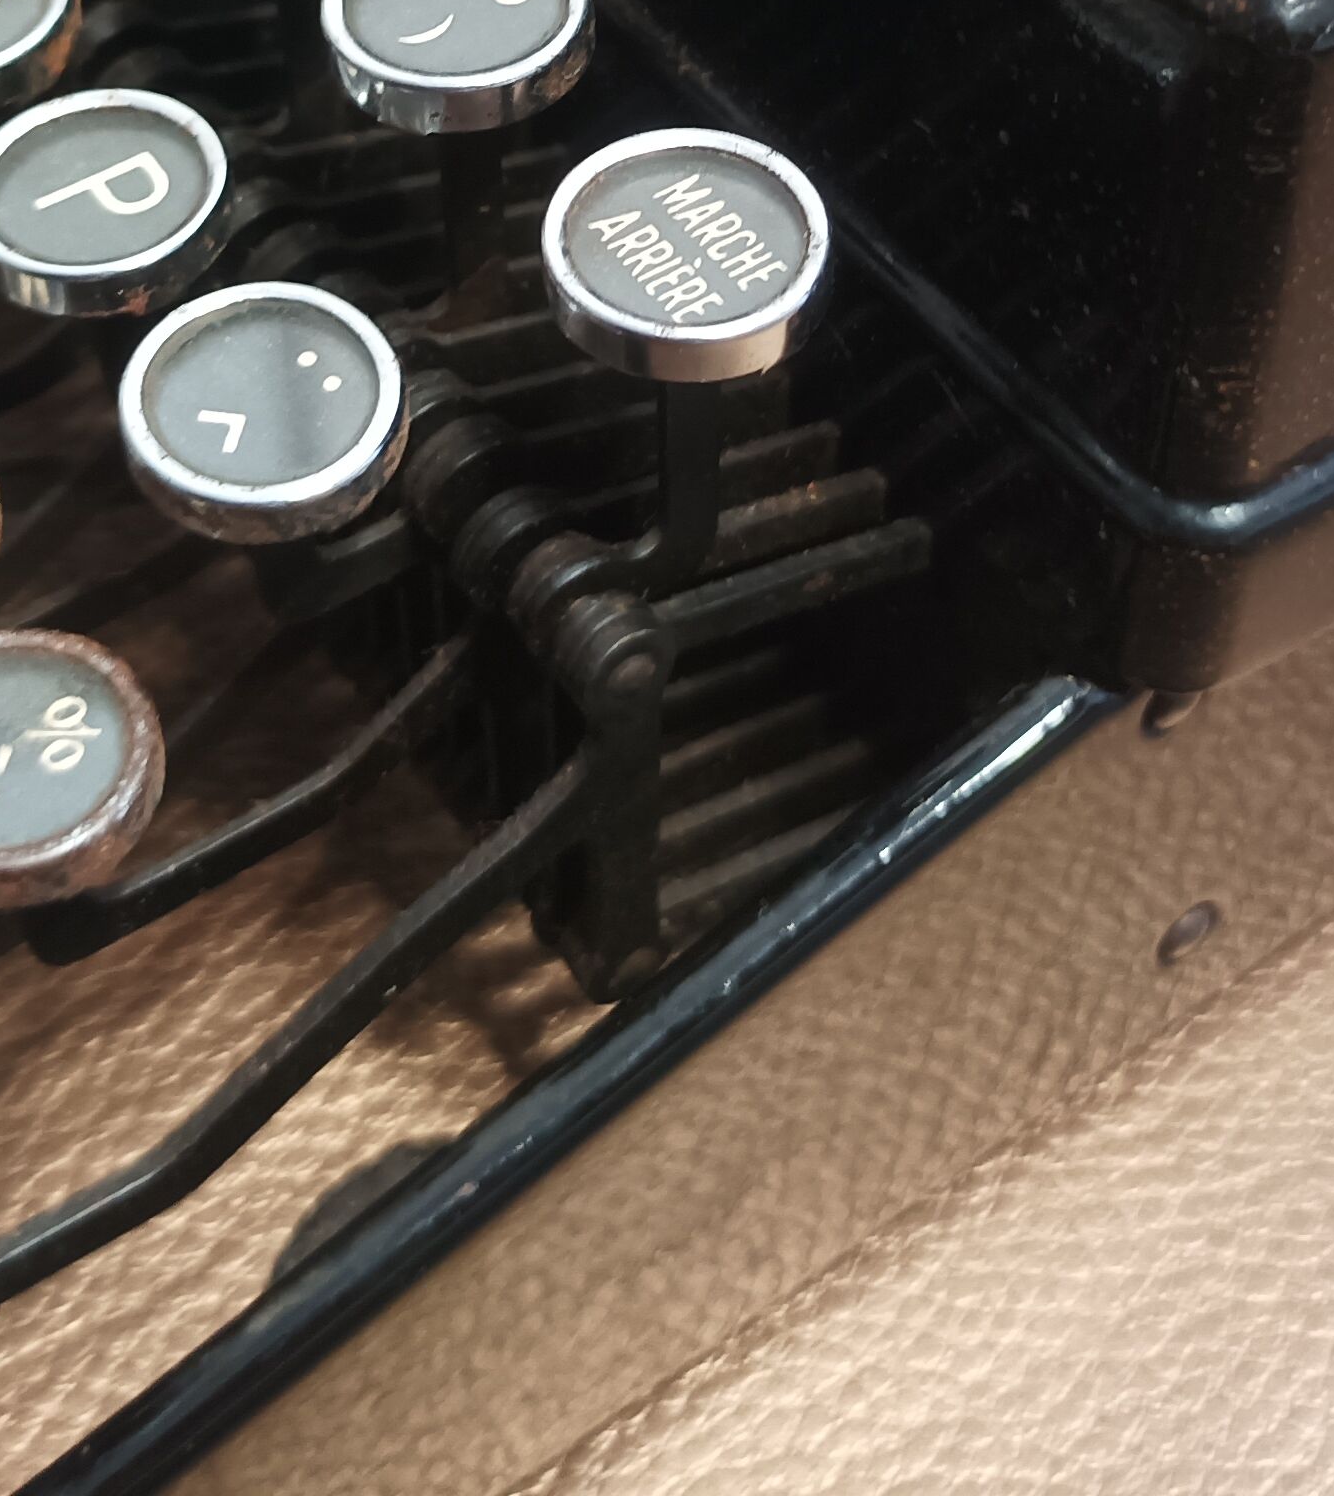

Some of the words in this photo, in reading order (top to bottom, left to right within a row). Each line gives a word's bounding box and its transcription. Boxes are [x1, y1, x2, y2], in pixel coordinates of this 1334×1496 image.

[34, 150, 169, 215] P
[587, 209, 725, 323] ARRIÈRE
[651, 174, 789, 293] MARCHE
[20, 695, 103, 772] %
